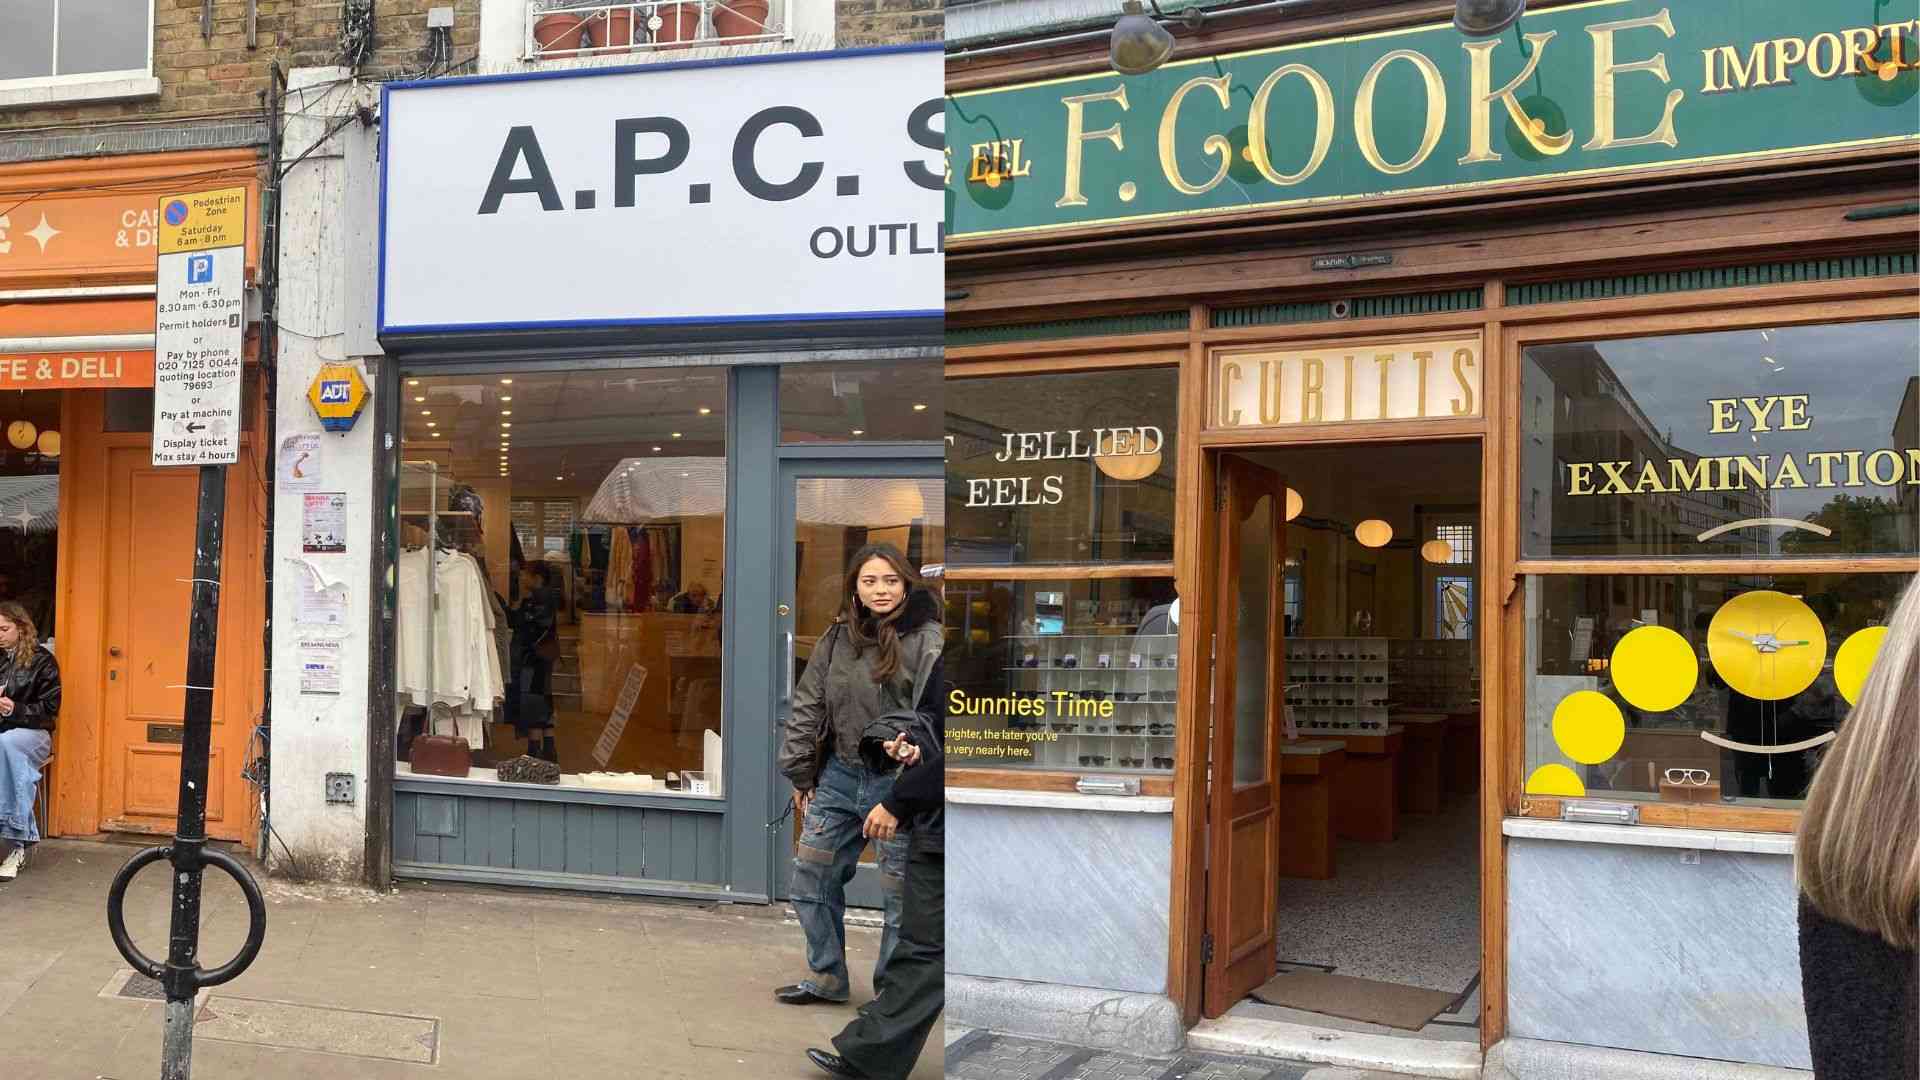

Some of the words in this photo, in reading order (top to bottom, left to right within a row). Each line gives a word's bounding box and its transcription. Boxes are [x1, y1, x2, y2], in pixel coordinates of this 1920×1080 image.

[1701, 18, 1920, 93] IMPORT
[477, 105, 860, 216] A.P.C.
[968, 138, 1032, 182] EEL
[193, 195, 241, 208] Pedestrian
[206, 208, 227, 217] Zone
[181, 224, 223, 236] Saturday
[809, 222, 944, 259] OUTL
[179, 290, 200, 299] Mon
[207, 287, 220, 297] Fri
[159, 321, 190, 331] Permit
[191, 317, 227, 328] holders
[167, 351, 184, 361] Pay
[186, 350, 198, 360] by
[200, 348, 230, 360] phone
[35, 358, 53, 380] &
[61, 356, 123, 379] DELI
[158, 361, 178, 371] 020
[182, 360, 205, 369] 7125
[209, 357, 239, 368] 0044
[159, 372, 195, 382] quoting
[197, 369, 236, 379] location
[183, 380, 213, 391] 79693
[321, 384, 351, 400] ADT
[1220, 348, 1475, 427] CUBITTS
[161, 411, 178, 421] Pay
[180, 410, 190, 419] at
[192, 408, 233, 418] machine
[1707, 393, 1813, 434] EYE
[163, 438, 197, 449] Display
[200, 437, 229, 447] ticket
[995, 426, 1165, 463] JELLIED
[154, 452, 173, 461] Max
[176, 452, 196, 462] stay
[199, 451, 206, 459] 4
[208, 450, 236, 460] hours
[965, 475, 1064, 508] EELS
[948, 689, 1046, 717] Sunnies
[1052, 691, 1114, 718] Time
[984, 729, 1000, 741] the
[1001, 729, 1025, 741] later
[1025, 730, 1058, 743] you've
[953, 746, 974, 757] very
[975, 745, 1005, 758] nearly
[1006, 745, 1032, 757] here.
